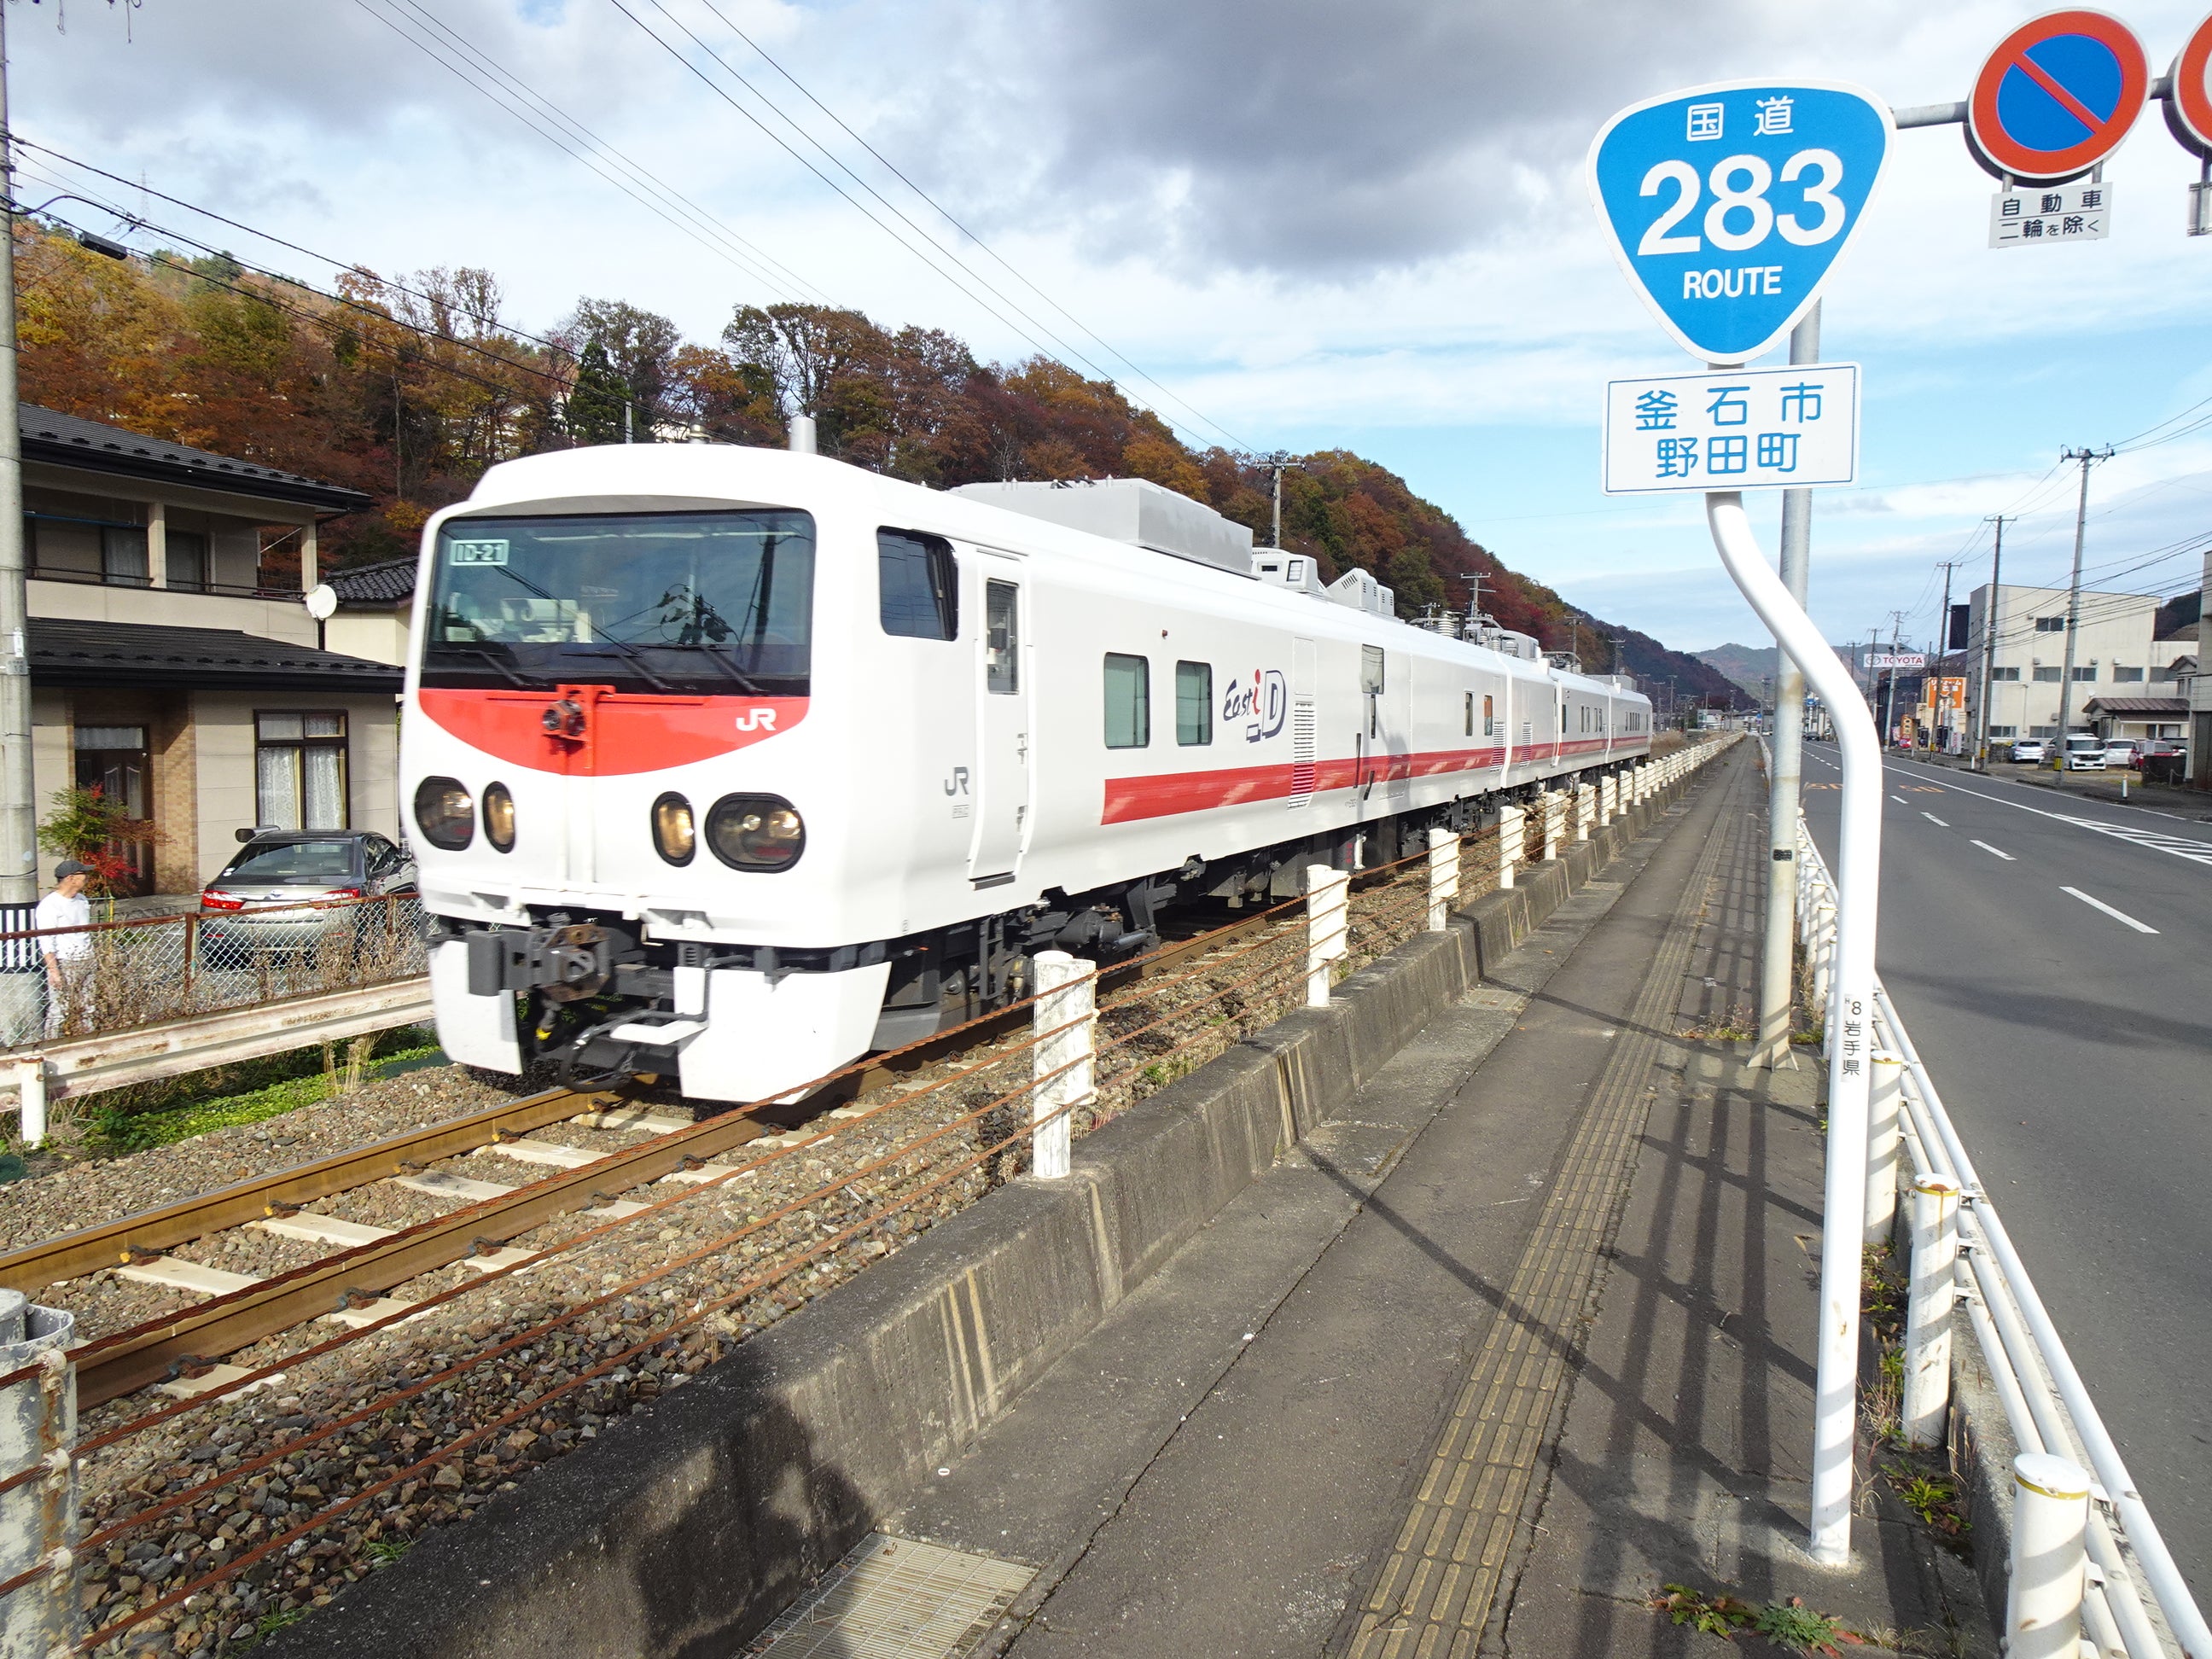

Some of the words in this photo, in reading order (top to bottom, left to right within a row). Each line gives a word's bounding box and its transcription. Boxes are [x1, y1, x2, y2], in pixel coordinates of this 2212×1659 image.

[1686, 96, 1795, 143] 国道
[1637, 148, 1847, 256] 283
[2001, 189, 2103, 217] 自動車
[1999, 214, 2100, 240] 二輪を除く
[1683, 265, 1784, 300] ROUTE
[1635, 382, 1825, 432] 釜石市
[1656, 433, 1802, 480] 野田町
[456, 544, 504, 562] ID-21
[1883, 656, 1923, 665] TOYOTA
[736, 707, 777, 732] JR
[944, 766, 969, 796] JR
